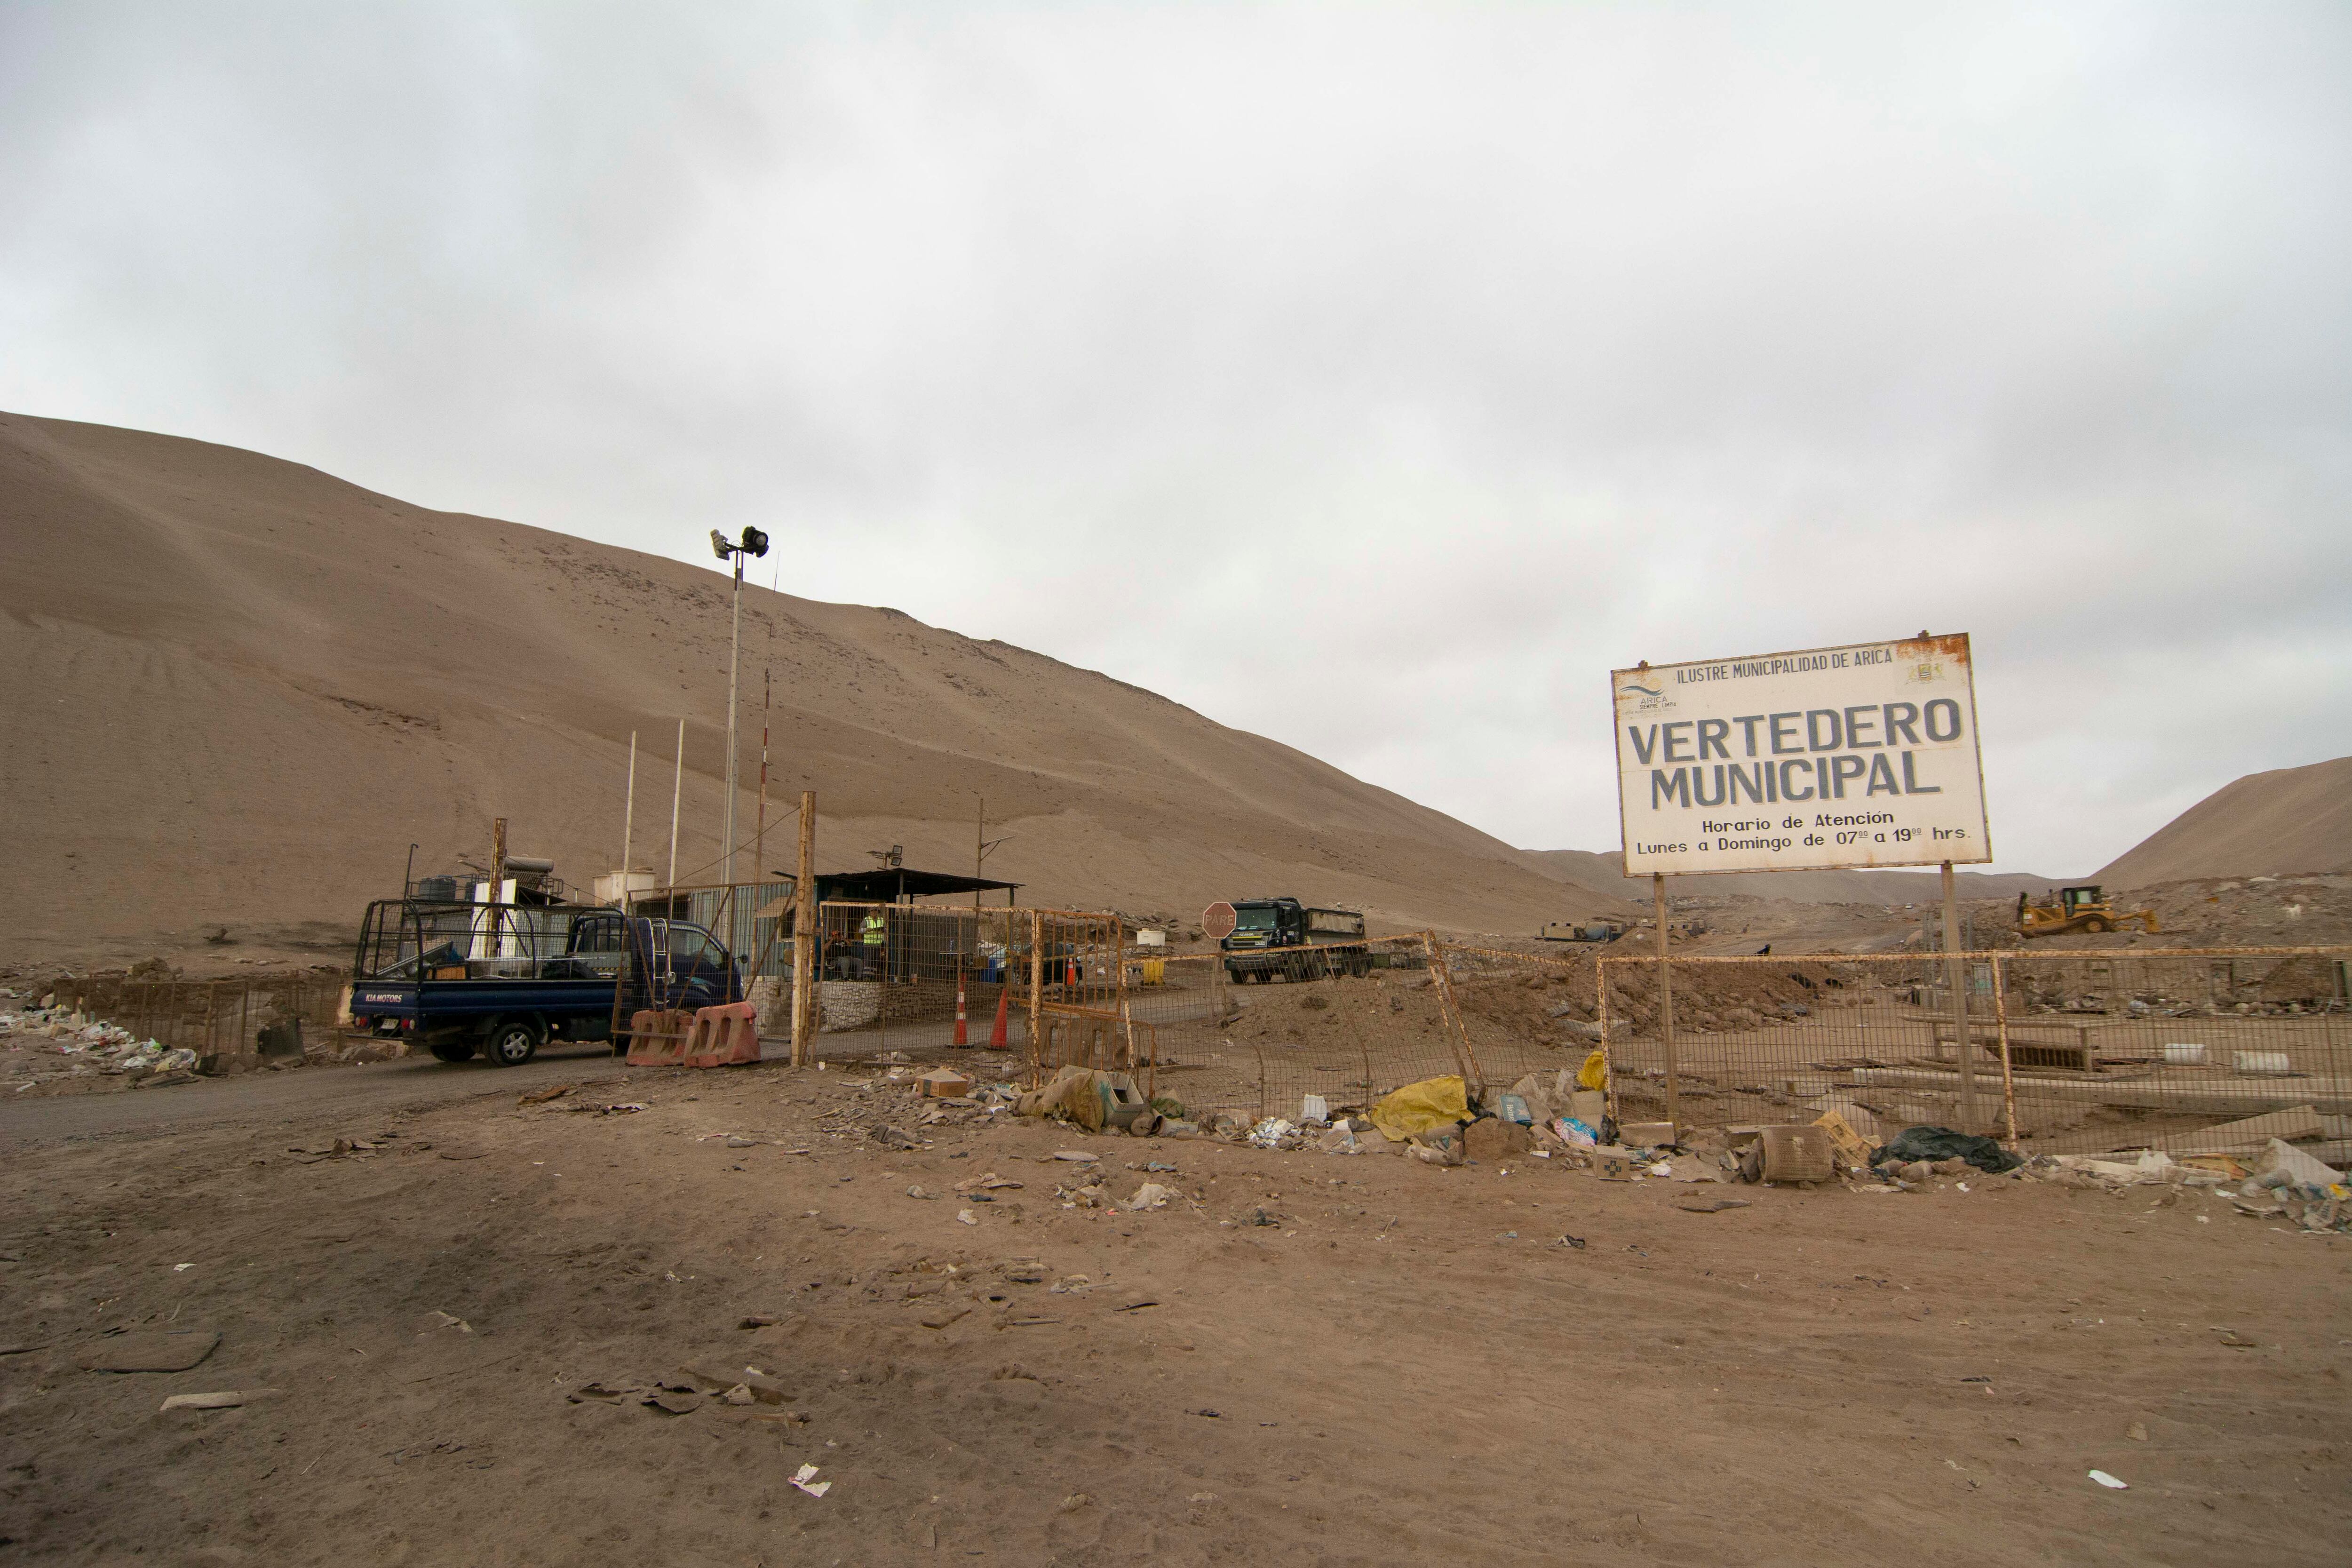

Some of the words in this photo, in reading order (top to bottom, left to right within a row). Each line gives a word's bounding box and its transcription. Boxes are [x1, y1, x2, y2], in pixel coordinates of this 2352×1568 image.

[1677, 665, 1728, 684] ILUSTRE
[1733, 655, 1827, 678] MUNICIPALIDAD
[1832, 653, 1849, 669] DE
[1855, 648, 1892, 667] ARICA
[1629, 699, 1963, 765] VERTEDERO
[1652, 751, 1942, 810] MUNICIPAL
[1703, 818, 1770, 833] Horario
[1782, 816, 1803, 828] de
[1815, 811, 1894, 827] Atención
[1637, 843, 1687, 854] Lunes
[1699, 842, 1708, 851] a
[1718, 836, 1791, 852] Domingo
[1804, 834, 1824, 845] de
[1875, 833, 1886, 843] a
[1932, 827, 1971, 840] hrs.
[1205, 915, 1234, 926] PARE
[376, 994, 402, 1003] MOTORS
